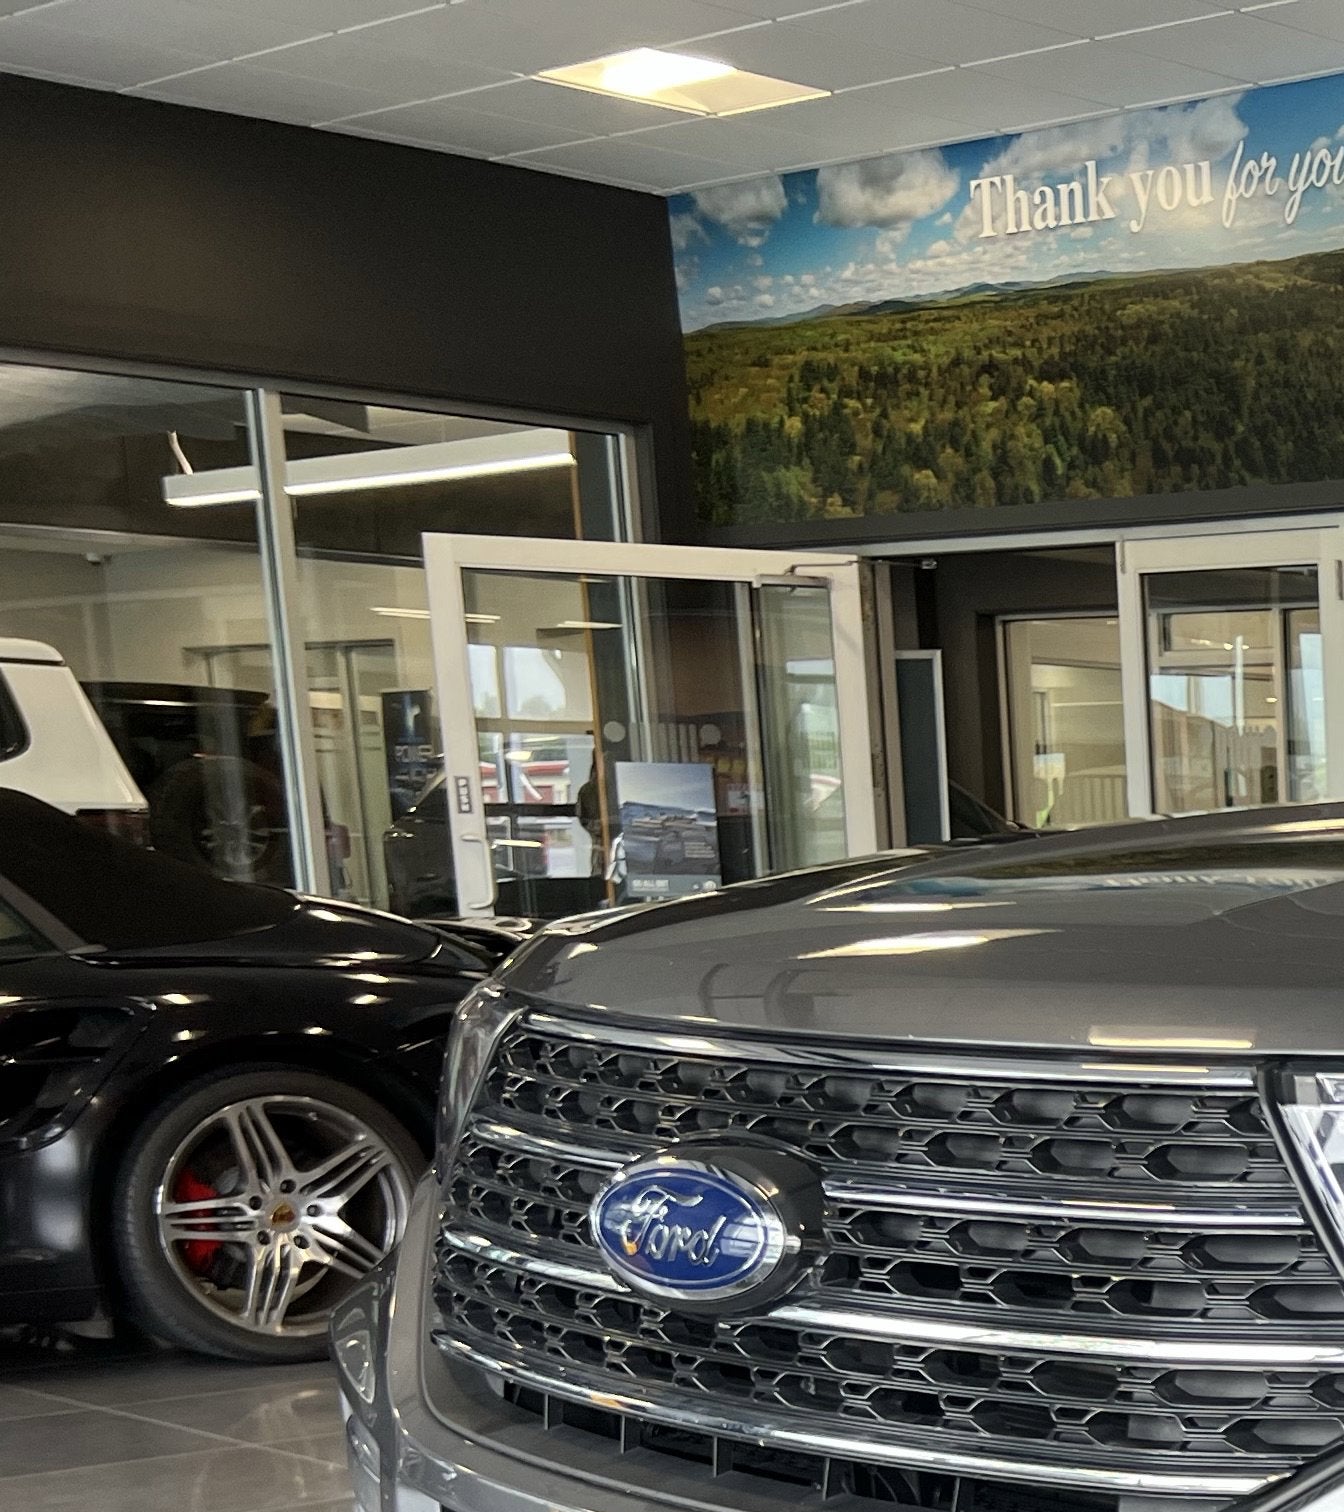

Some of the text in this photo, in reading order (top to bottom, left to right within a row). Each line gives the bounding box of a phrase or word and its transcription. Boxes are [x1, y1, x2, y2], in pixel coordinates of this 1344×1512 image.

[969, 159, 1119, 238] Thank
[1129, 159, 1215, 233] you
[1221, 140, 1278, 228] for
[621, 1184, 727, 1267] Ford
